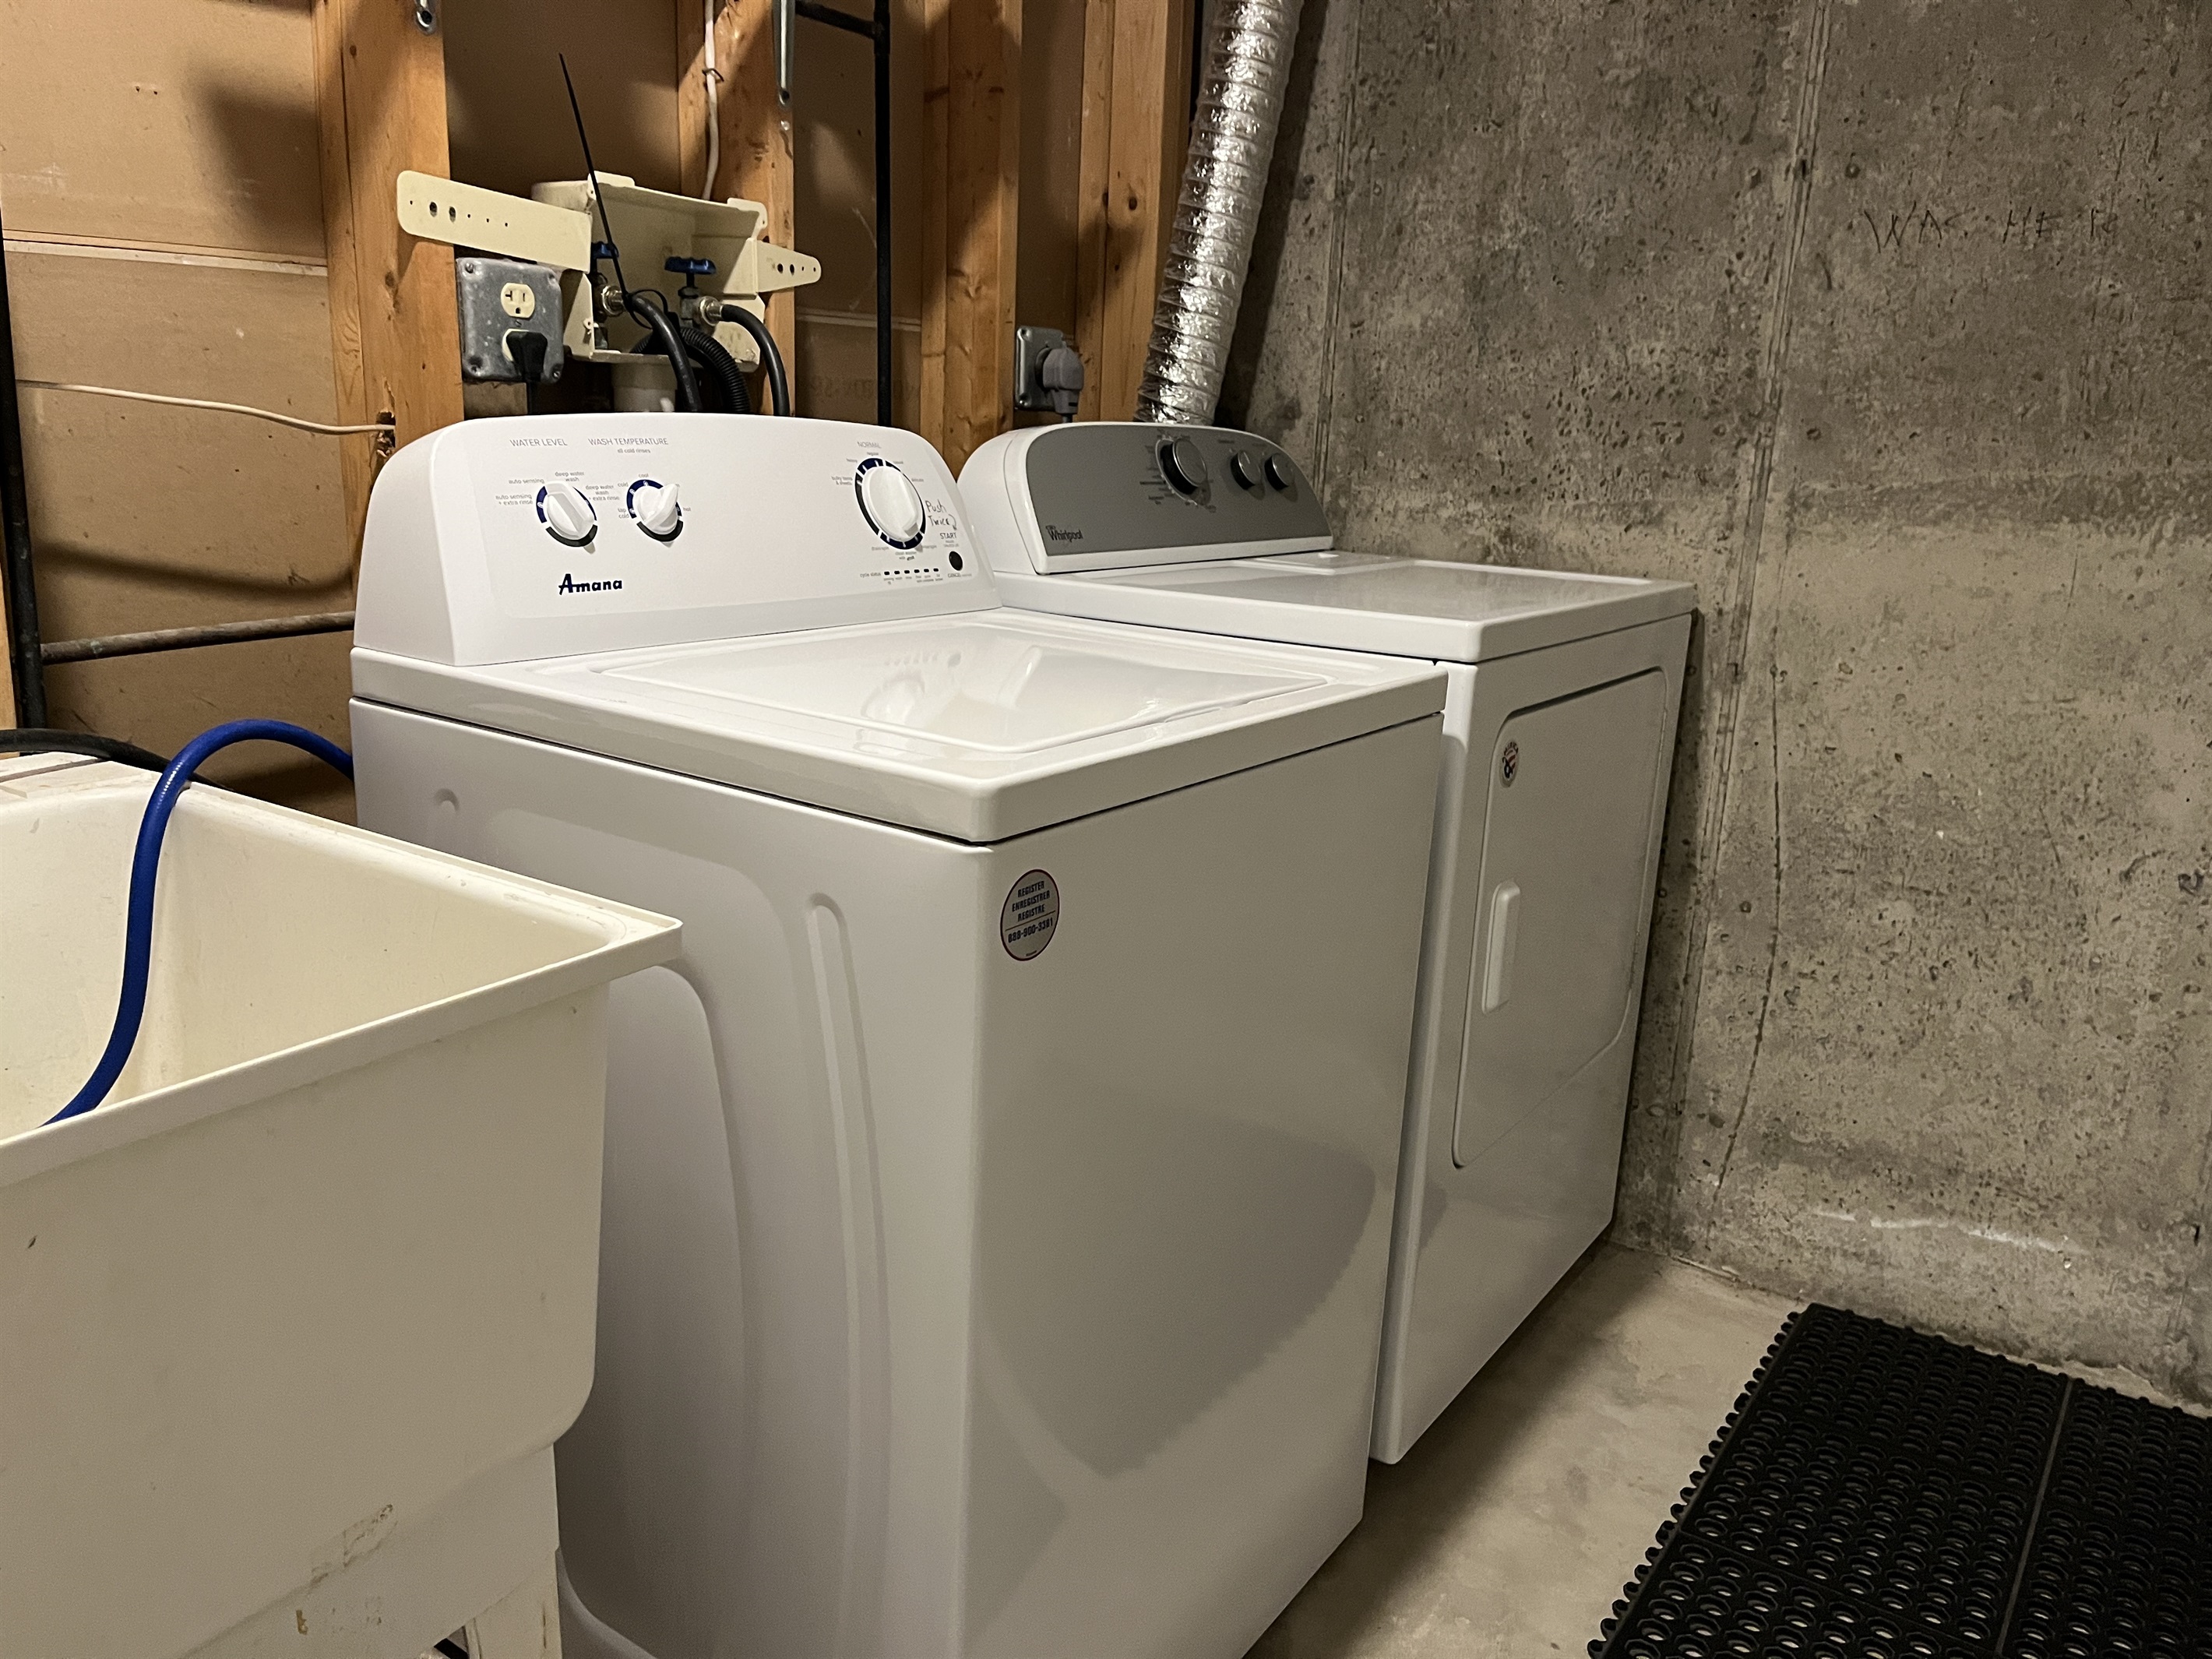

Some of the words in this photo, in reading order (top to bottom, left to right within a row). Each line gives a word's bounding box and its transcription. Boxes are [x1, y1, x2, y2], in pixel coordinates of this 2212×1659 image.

[509, 439, 540, 447] WATER
[541, 438, 568, 446] LEVEL
[588, 438, 613, 446] WASH
[615, 438, 669, 446] TEMPERATURE
[925, 498, 947, 513] Push
[928, 515, 950, 526] Twice
[1047, 528, 1083, 543] Whirlpool
[558, 573, 622, 595] Amana
[1017, 880, 1044, 897] REGISTER
[1012, 889, 1051, 912] ENREGISTRER
[1017, 903, 1045, 922] REGISTRE
